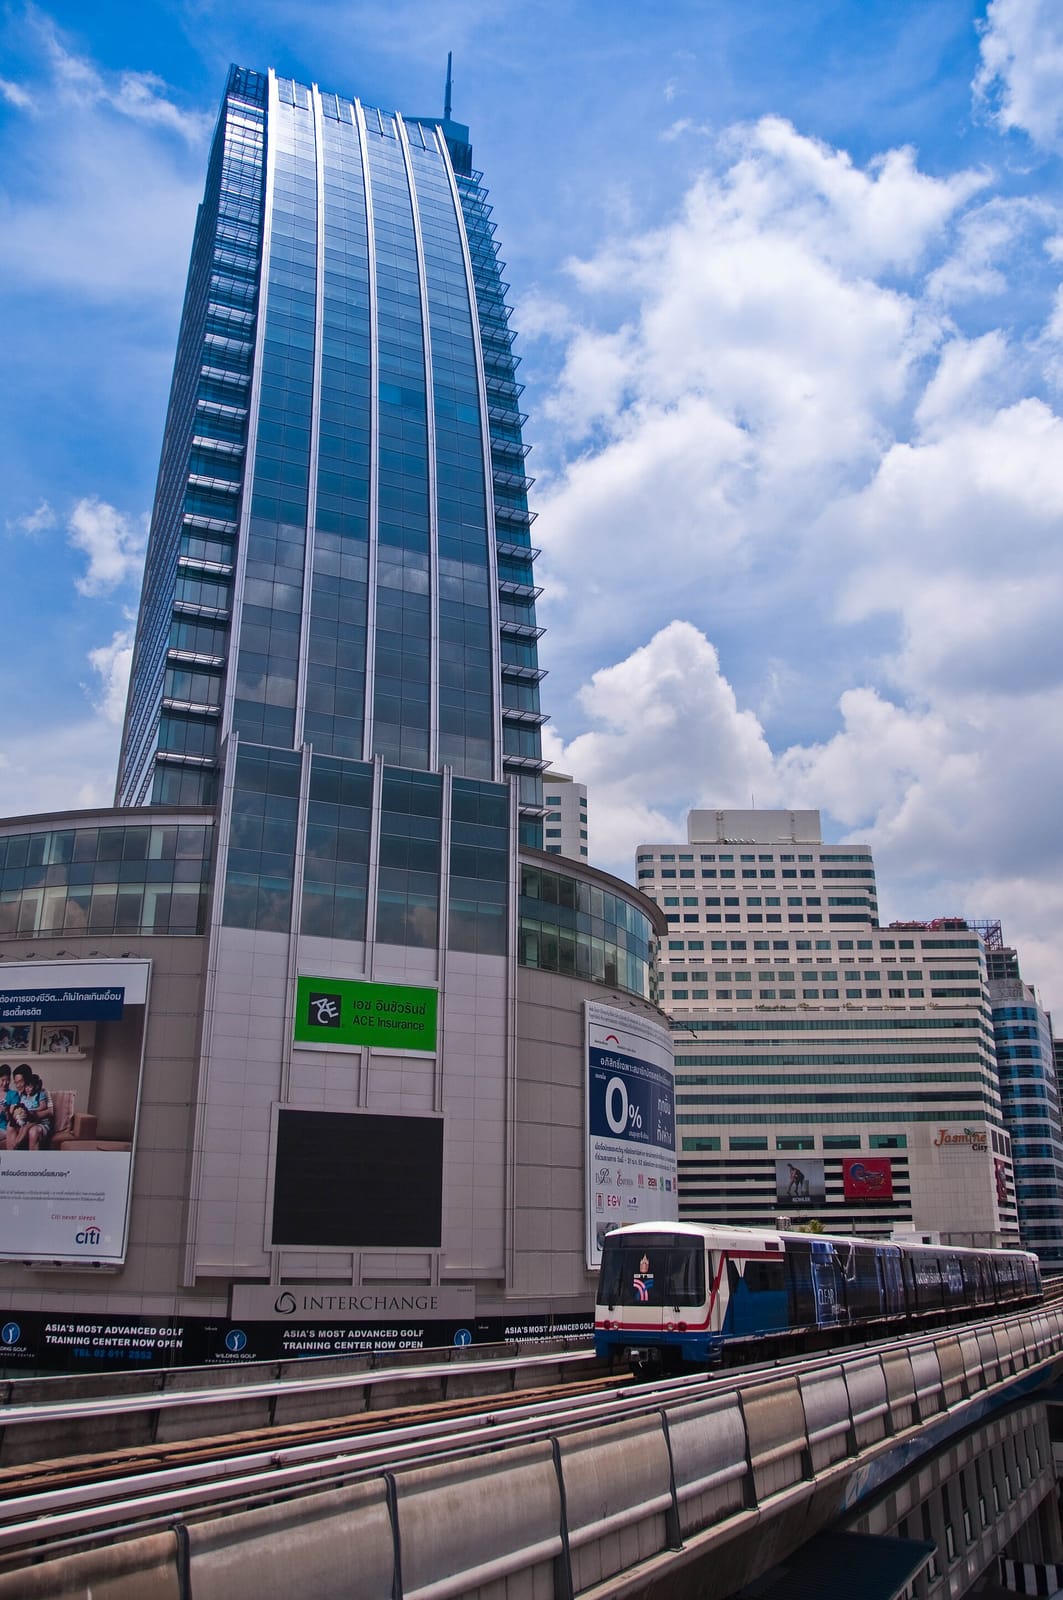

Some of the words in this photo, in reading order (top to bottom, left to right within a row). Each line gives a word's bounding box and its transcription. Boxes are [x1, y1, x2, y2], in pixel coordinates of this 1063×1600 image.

[353, 1016, 375, 1026] ACE
[377, 1017, 425, 1030] Insurance
[934, 1129, 986, 1146] Jasmine
[971, 1144, 988, 1152] City
[75, 1229, 101, 1245] citi
[303, 1295, 438, 1311] INTERCHANGE
[45, 1323, 75, 1332] ASIA'S
[76, 1325, 103, 1334] MOST
[105, 1326, 157, 1335] ADVANCED
[159, 1328, 184, 1336] GOLF
[283, 1330, 316, 1338] ASIA'S
[318, 1330, 346, 1338] MOST
[348, 1330, 398, 1338] ADVANCED
[400, 1329, 424, 1337] GOLF
[505, 1325, 528, 1334] ASIA'S
[528, 1325, 548, 1333] MOST
[549, 1323, 579, 1332] ADVANCED
[580, 1322, 594, 1330] GOLF
[45, 1335, 90, 1345] TRAINING
[92, 1337, 130, 1346] CENTER
[132, 1339, 155, 1347] NOW
[157, 1340, 183, 1348] OPEN
[374, 1341, 396, 1349] NOW
[74, 1348, 91, 1357] TEL
[94, 1349, 105, 1358] 02
